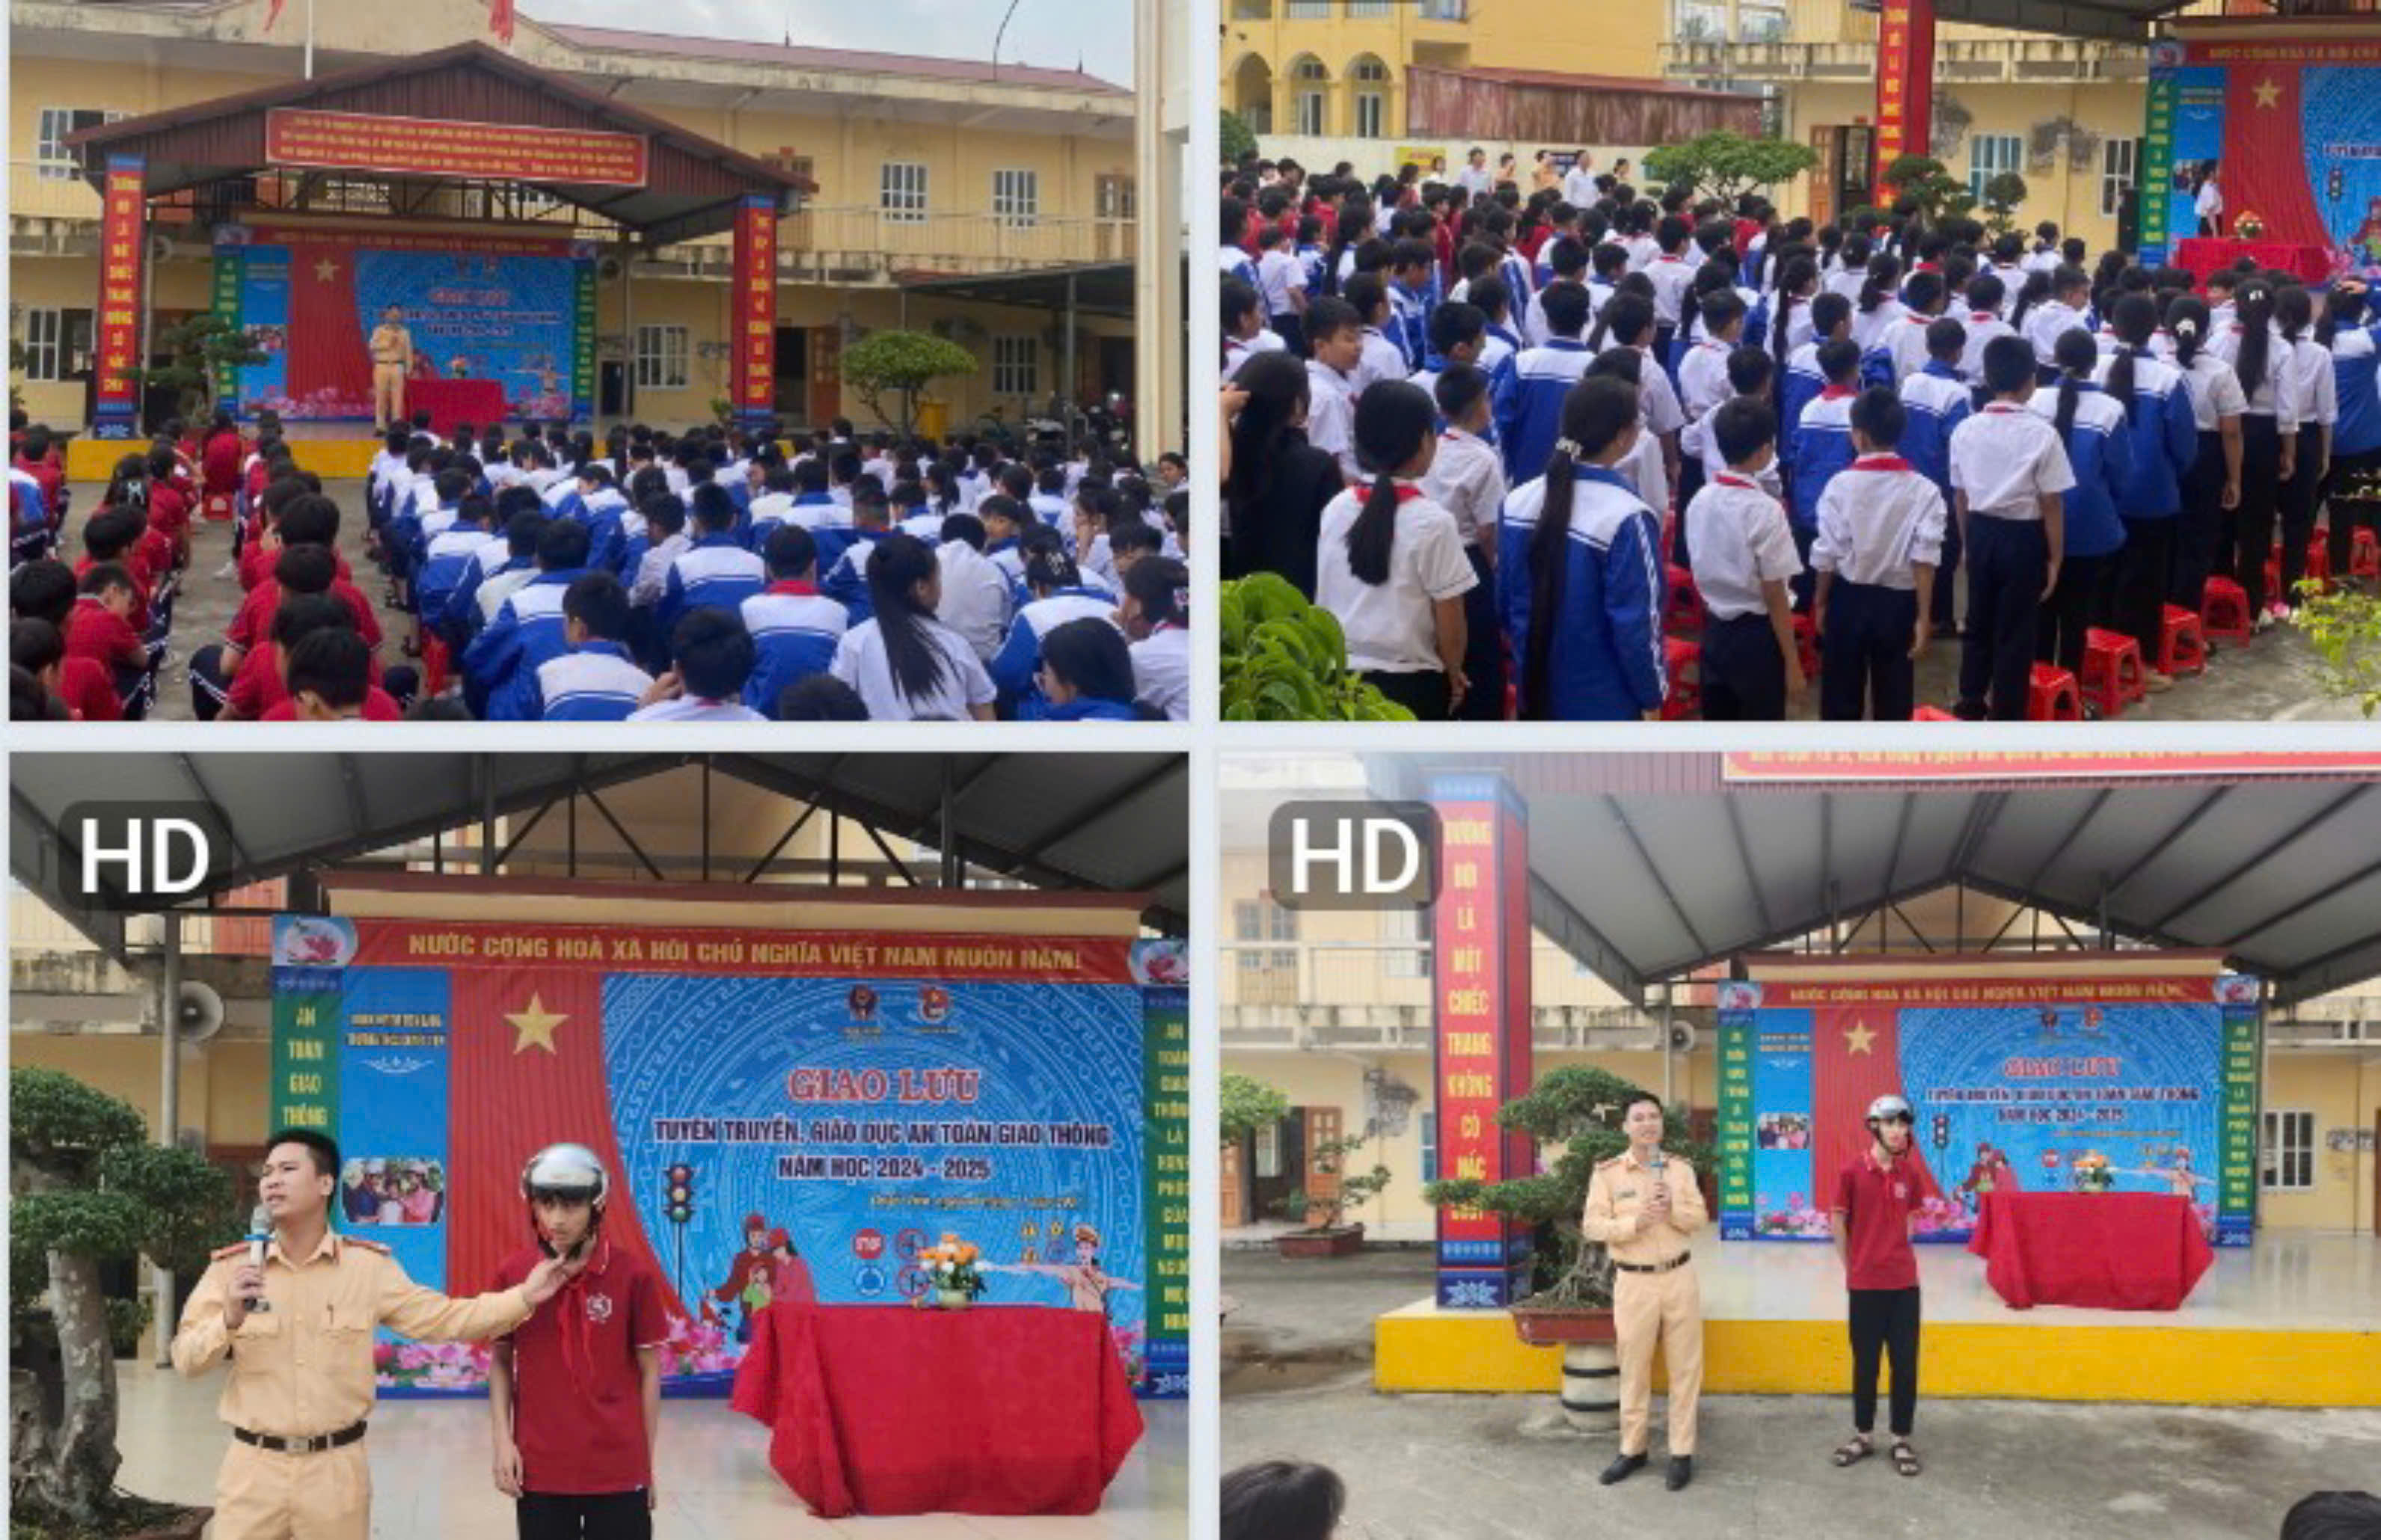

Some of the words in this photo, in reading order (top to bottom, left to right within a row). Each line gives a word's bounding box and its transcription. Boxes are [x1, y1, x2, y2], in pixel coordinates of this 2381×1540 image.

[751, 940, 821, 964] NGHĨA
[884, 946, 937, 966] NAM
[788, 1067, 889, 1102] GIAO
[898, 1063, 981, 1102] LƯU
[655, 1118, 717, 1142] TUYÊN
[907, 1122, 935, 1144] AN
[998, 1123, 1041, 1144] GIAO
[1048, 1119, 1112, 1147] THÔNG
[876, 1157, 925, 1179] 2024
[943, 1157, 992, 1180] 2025
